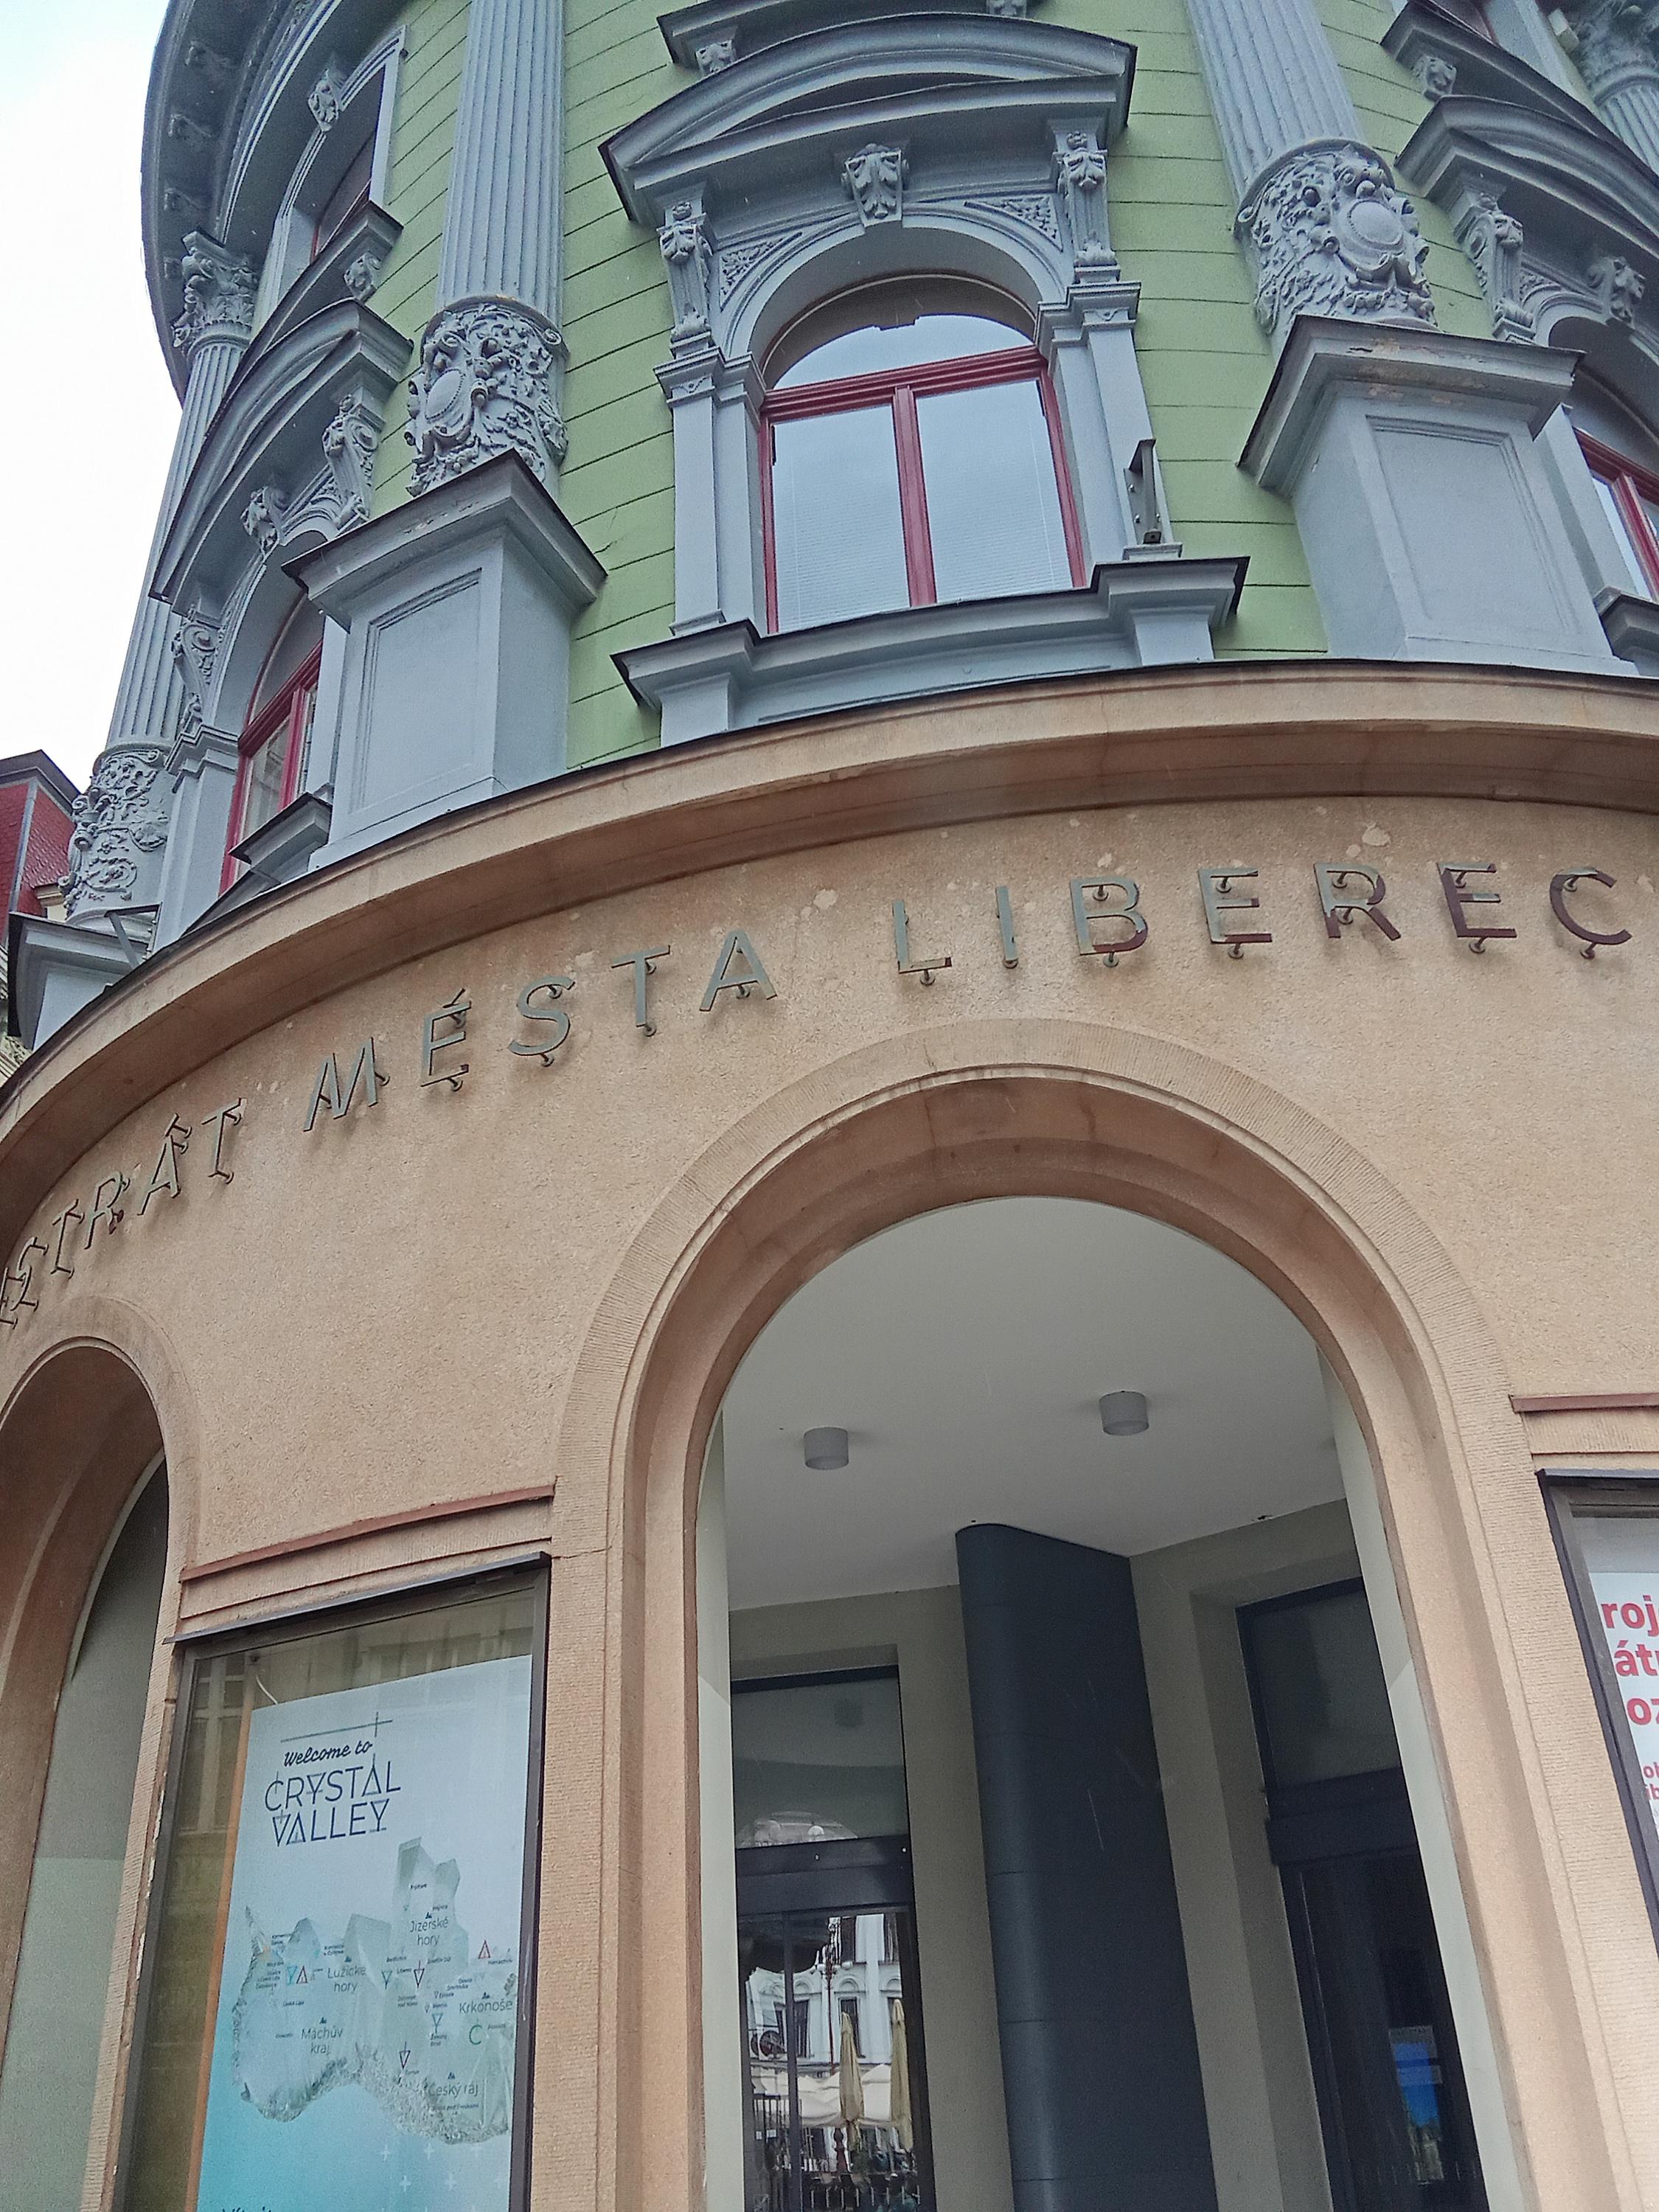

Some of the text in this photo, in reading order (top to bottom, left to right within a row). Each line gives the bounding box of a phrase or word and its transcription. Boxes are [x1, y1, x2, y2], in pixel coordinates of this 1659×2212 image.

[892, 861, 1632, 973] LIBEREC
[284, 1740, 373, 1767] Welcome to
[265, 1758, 401, 1812] CRYSTAL
[272, 1798, 389, 1847] VALLEY
[410, 1917, 448, 1933] Jizerské
[417, 1934, 440, 1947] hory
[459, 1998, 513, 2014] Krkonoše
